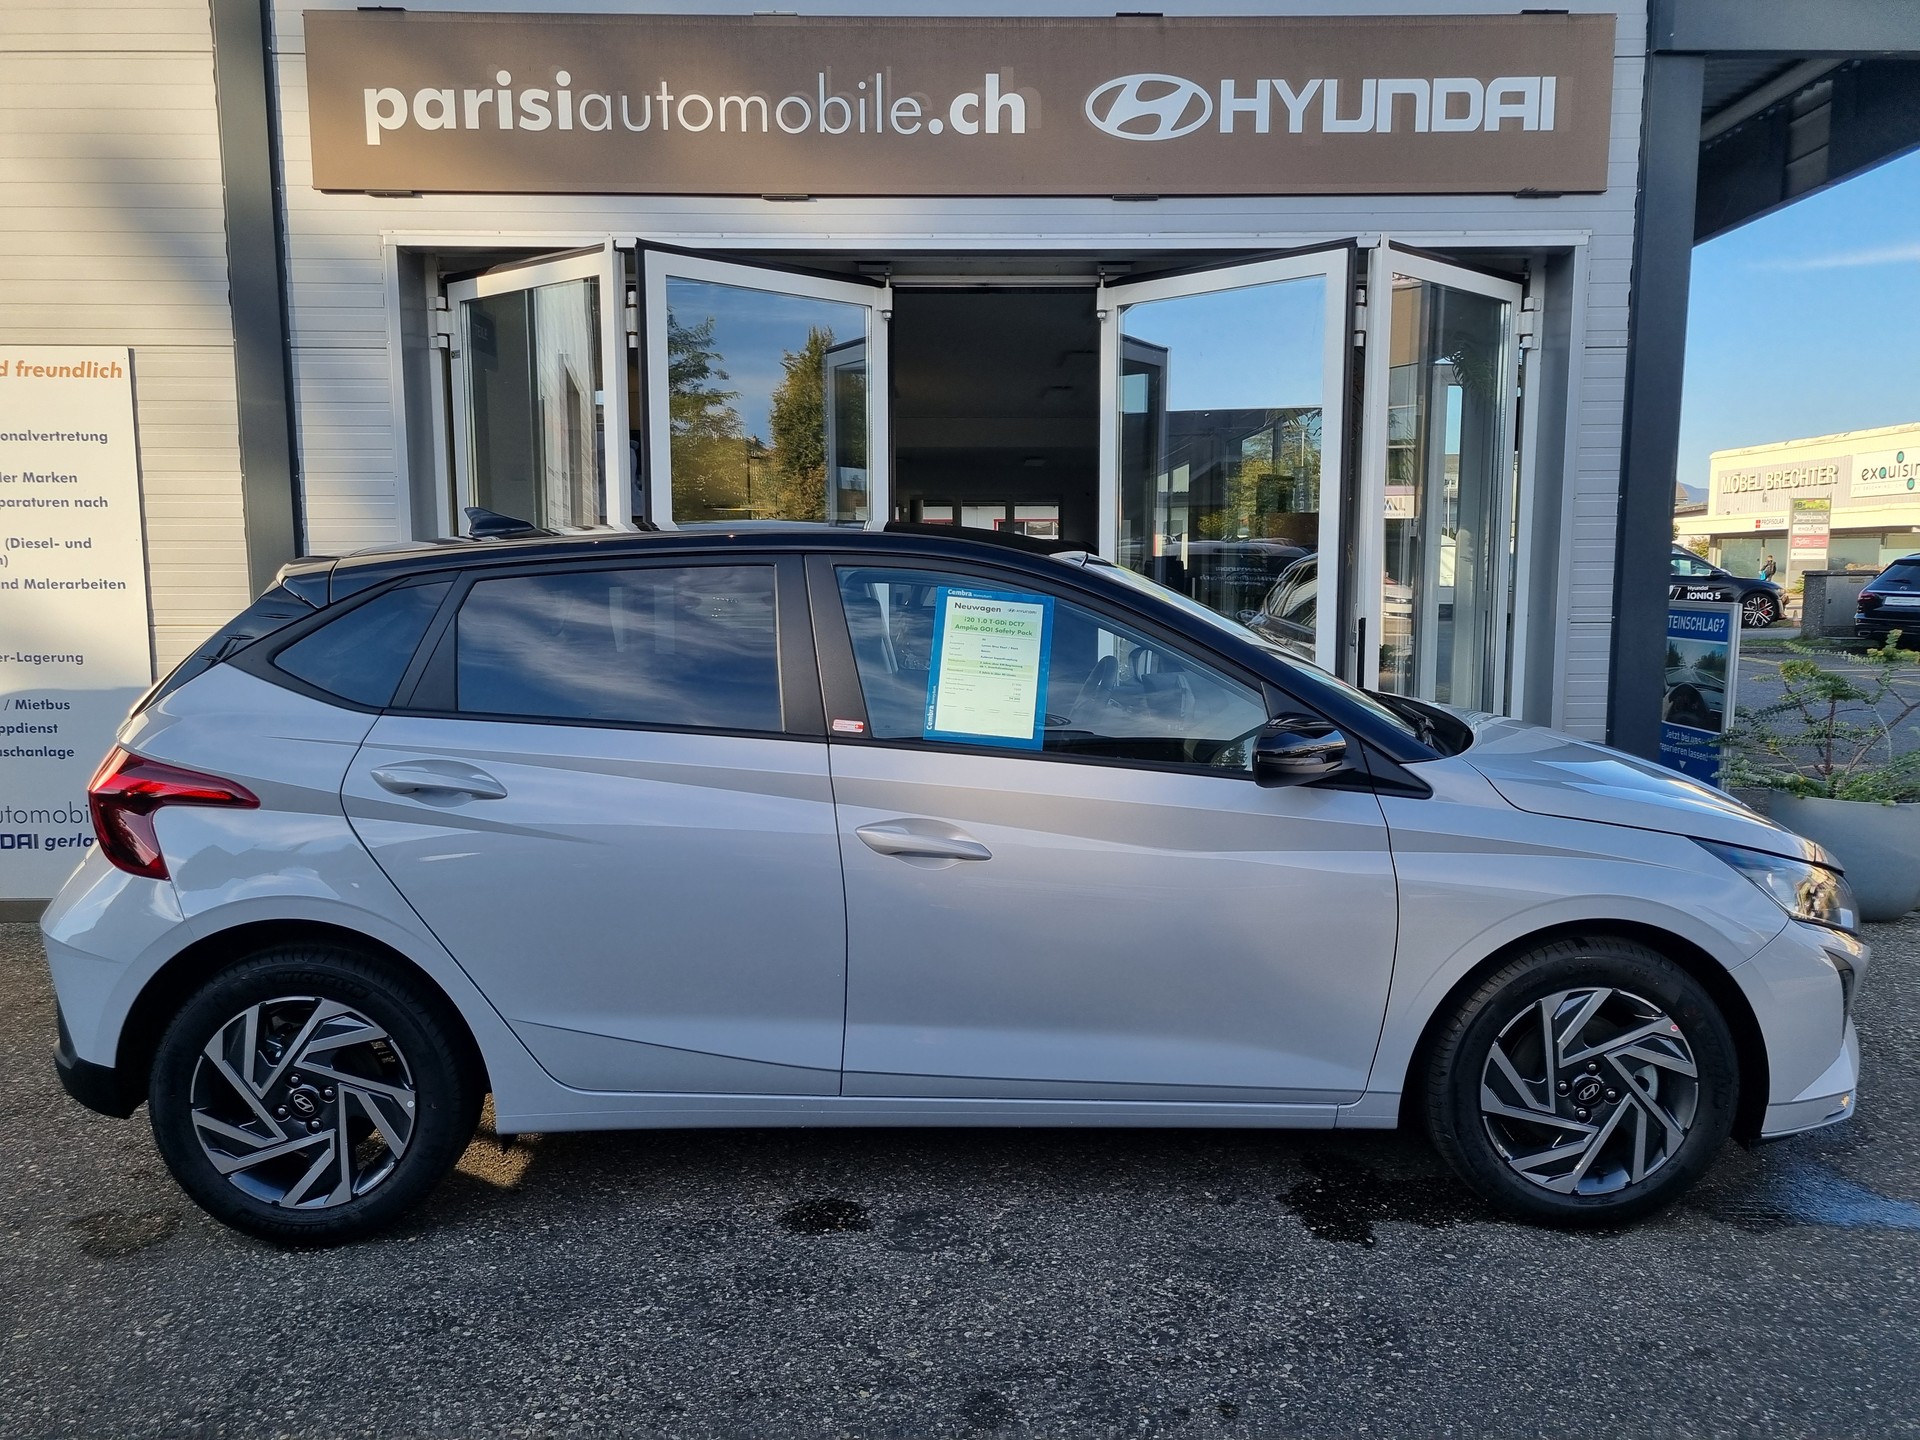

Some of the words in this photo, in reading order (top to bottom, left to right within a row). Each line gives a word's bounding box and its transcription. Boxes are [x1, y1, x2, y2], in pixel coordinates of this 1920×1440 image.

[363, 70, 1026, 146] parisiautomobile.ch
[1219, 76, 1556, 133] HYUNDAI
[16, 360, 122, 378] freundlich
[0, 430, 108, 444] onalvertretung
[22, 472, 77, 483] Marken
[1721, 472, 1763, 494] MÖBEL
[1765, 465, 1838, 490] BRECHTER
[0, 498, 69, 511] paraturen
[75, 497, 108, 508] nach
[5, 537, 59, 551] (Diesel-
[65, 537, 92, 549] und
[1, 578, 19, 590] nd
[24, 578, 126, 590] Malerarbeiten
[947, 589, 973, 597] Cembra
[1687, 592, 1714, 600] IONIQ
[1715, 592, 1721, 600] 5
[954, 602, 1002, 613] Neuwagen
[1668, 615, 1725, 632] TEINSCHLAG?
[995, 627, 1016, 636] Safety
[15, 699, 70, 710] Mietbus
[926, 704, 934, 730] Cembra
[1666, 729, 1680, 740] Jetzt
[0, 834, 39, 849] DAI
[45, 833, 98, 851] gerla
